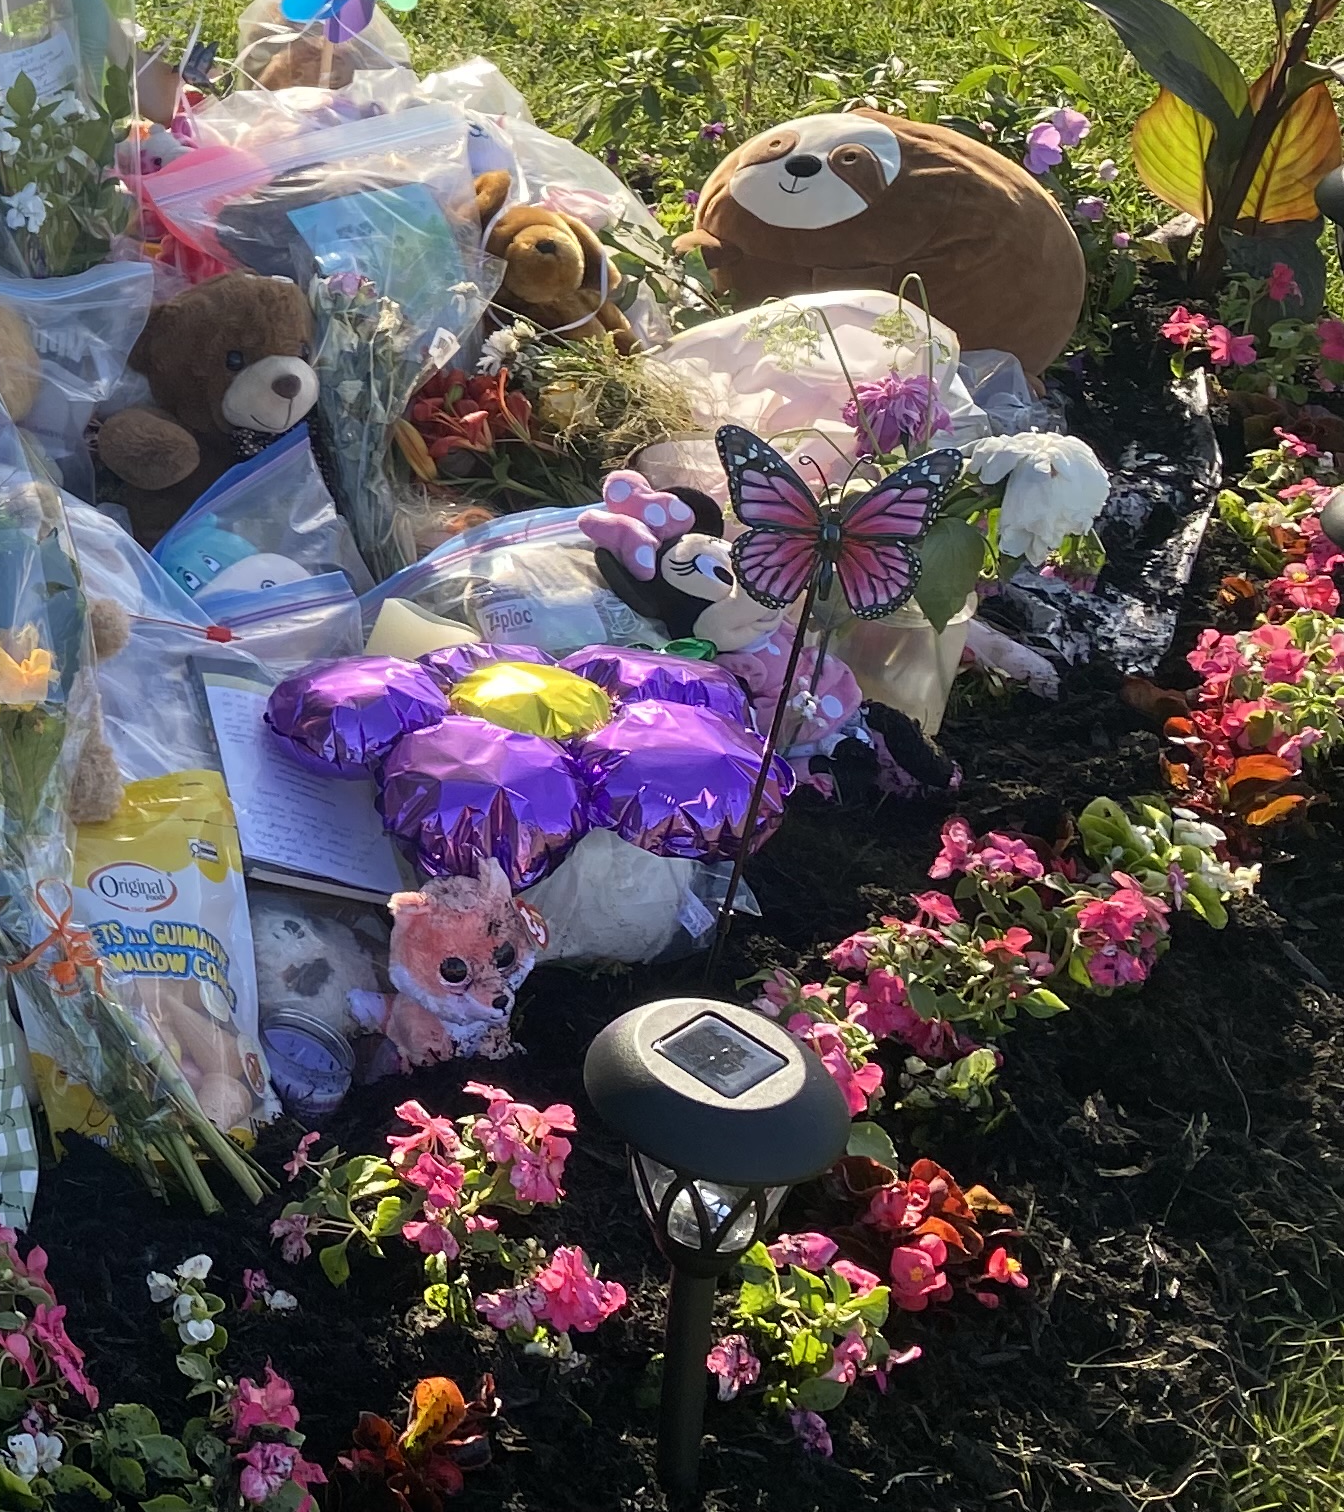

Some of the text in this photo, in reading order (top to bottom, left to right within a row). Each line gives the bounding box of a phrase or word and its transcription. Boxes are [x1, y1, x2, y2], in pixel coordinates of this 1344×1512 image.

[485, 609, 534, 633] Ziploc
[99, 874, 166, 898] Original
[109, 951, 188, 974] MALLOW
